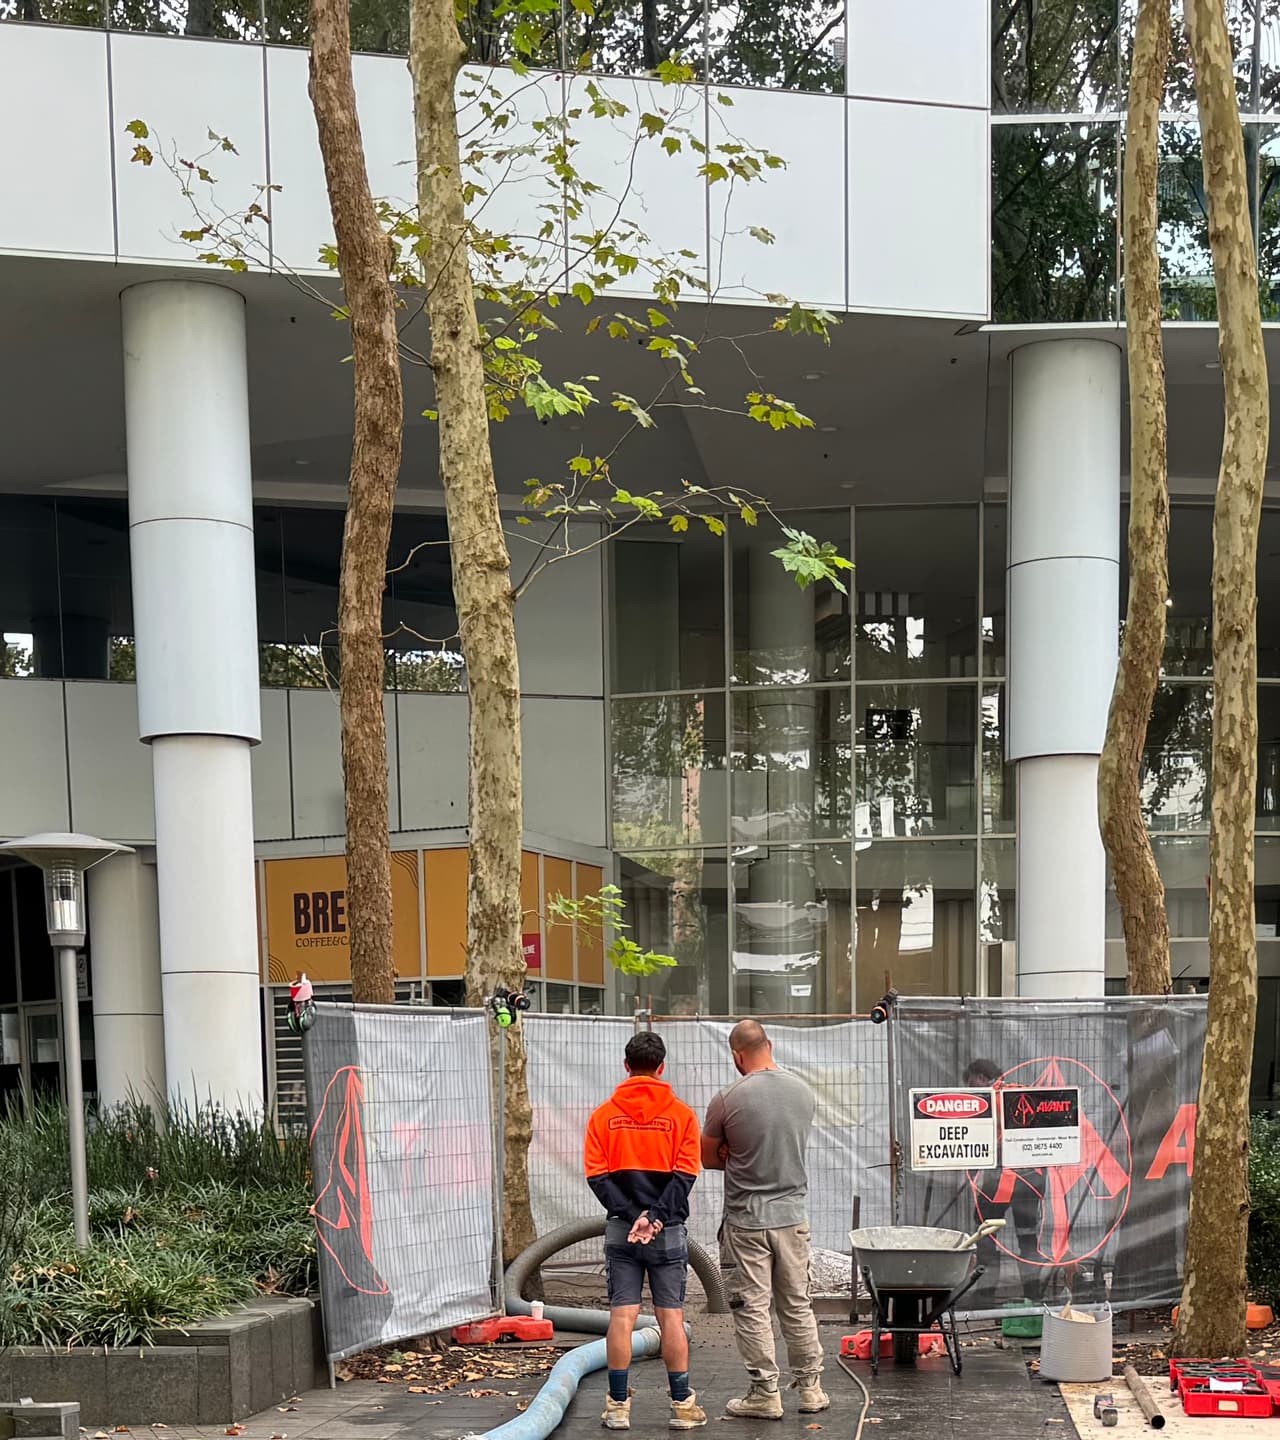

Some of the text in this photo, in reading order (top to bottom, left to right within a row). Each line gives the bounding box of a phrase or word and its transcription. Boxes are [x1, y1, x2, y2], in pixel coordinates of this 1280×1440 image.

[294, 890, 351, 934] BRE
[926, 1100, 980, 1112] DANGER
[1036, 1101, 1072, 1113] AVANT
[939, 1126, 969, 1140] DEEP
[919, 1144, 989, 1159] EXCAVATION
